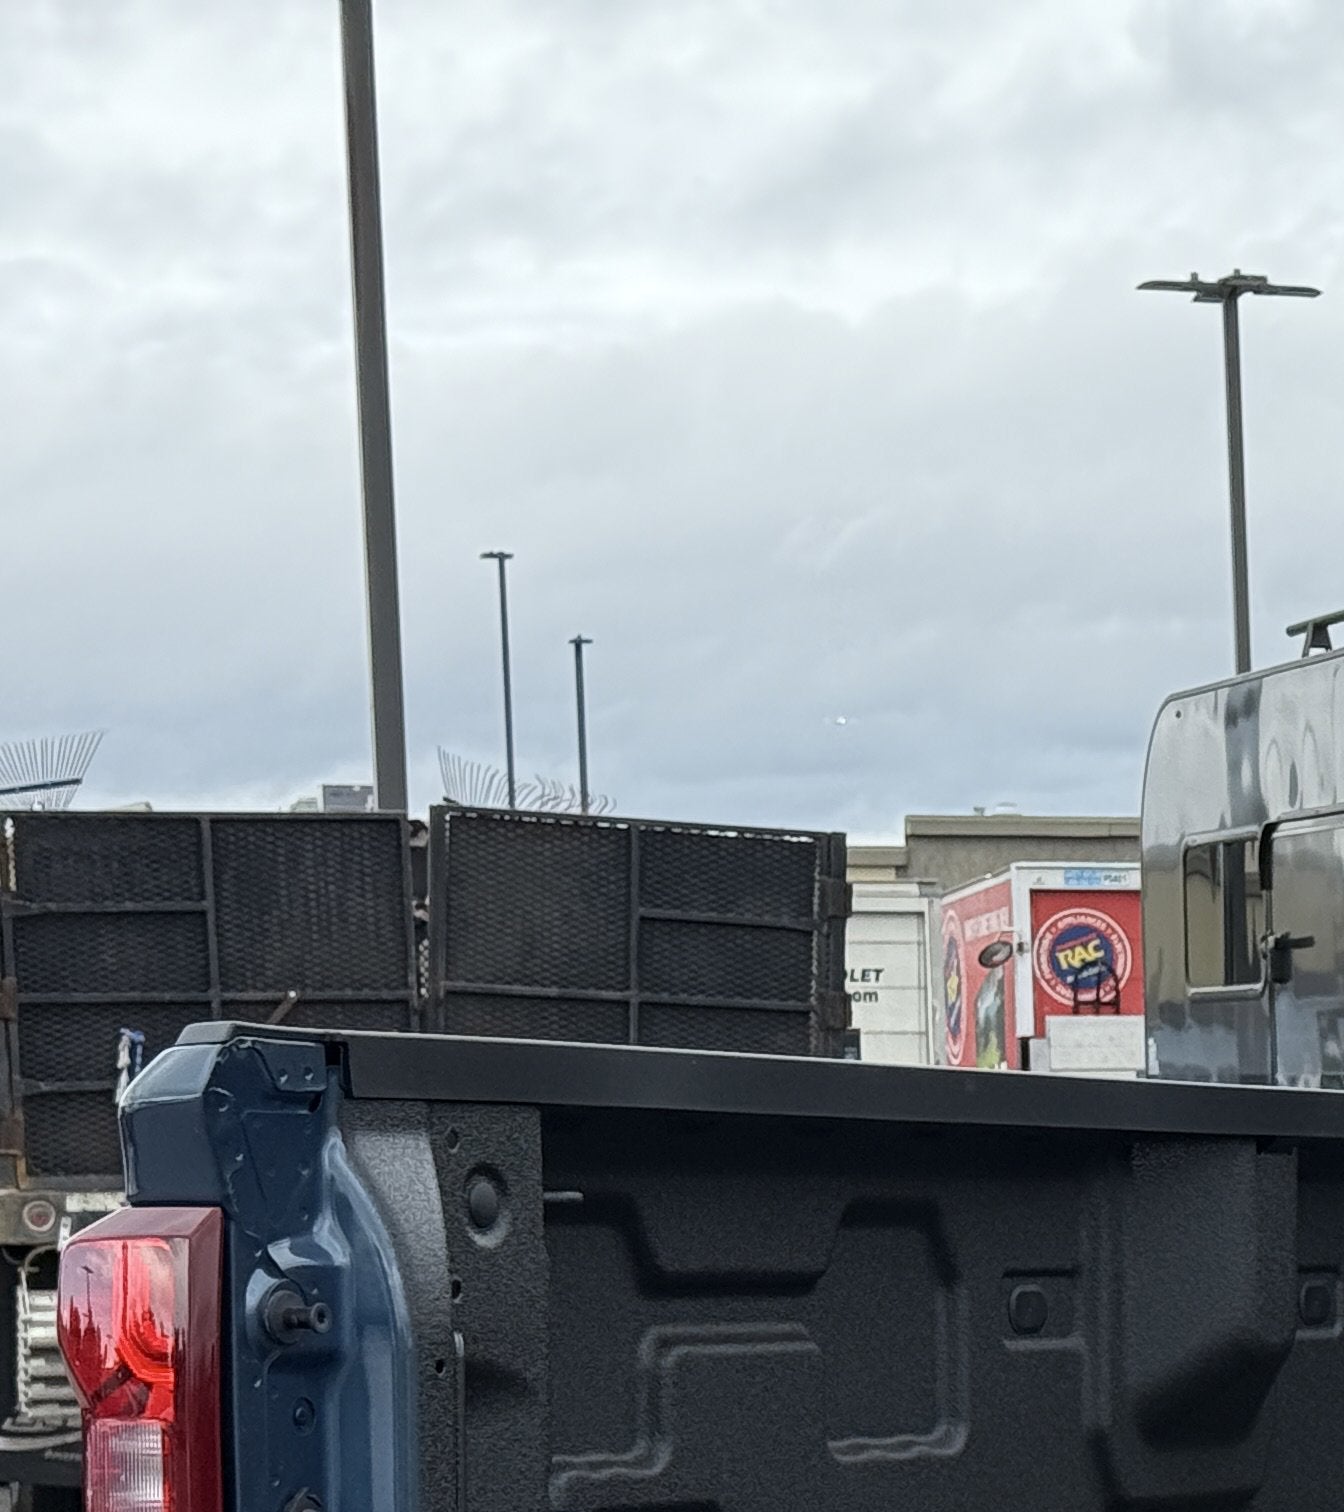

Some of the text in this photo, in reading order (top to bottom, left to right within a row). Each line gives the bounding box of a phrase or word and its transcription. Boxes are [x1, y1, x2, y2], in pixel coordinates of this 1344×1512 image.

[1055, 938, 1105, 970] RAC
[849, 968, 885, 982] LET
[851, 991, 879, 1003] om
